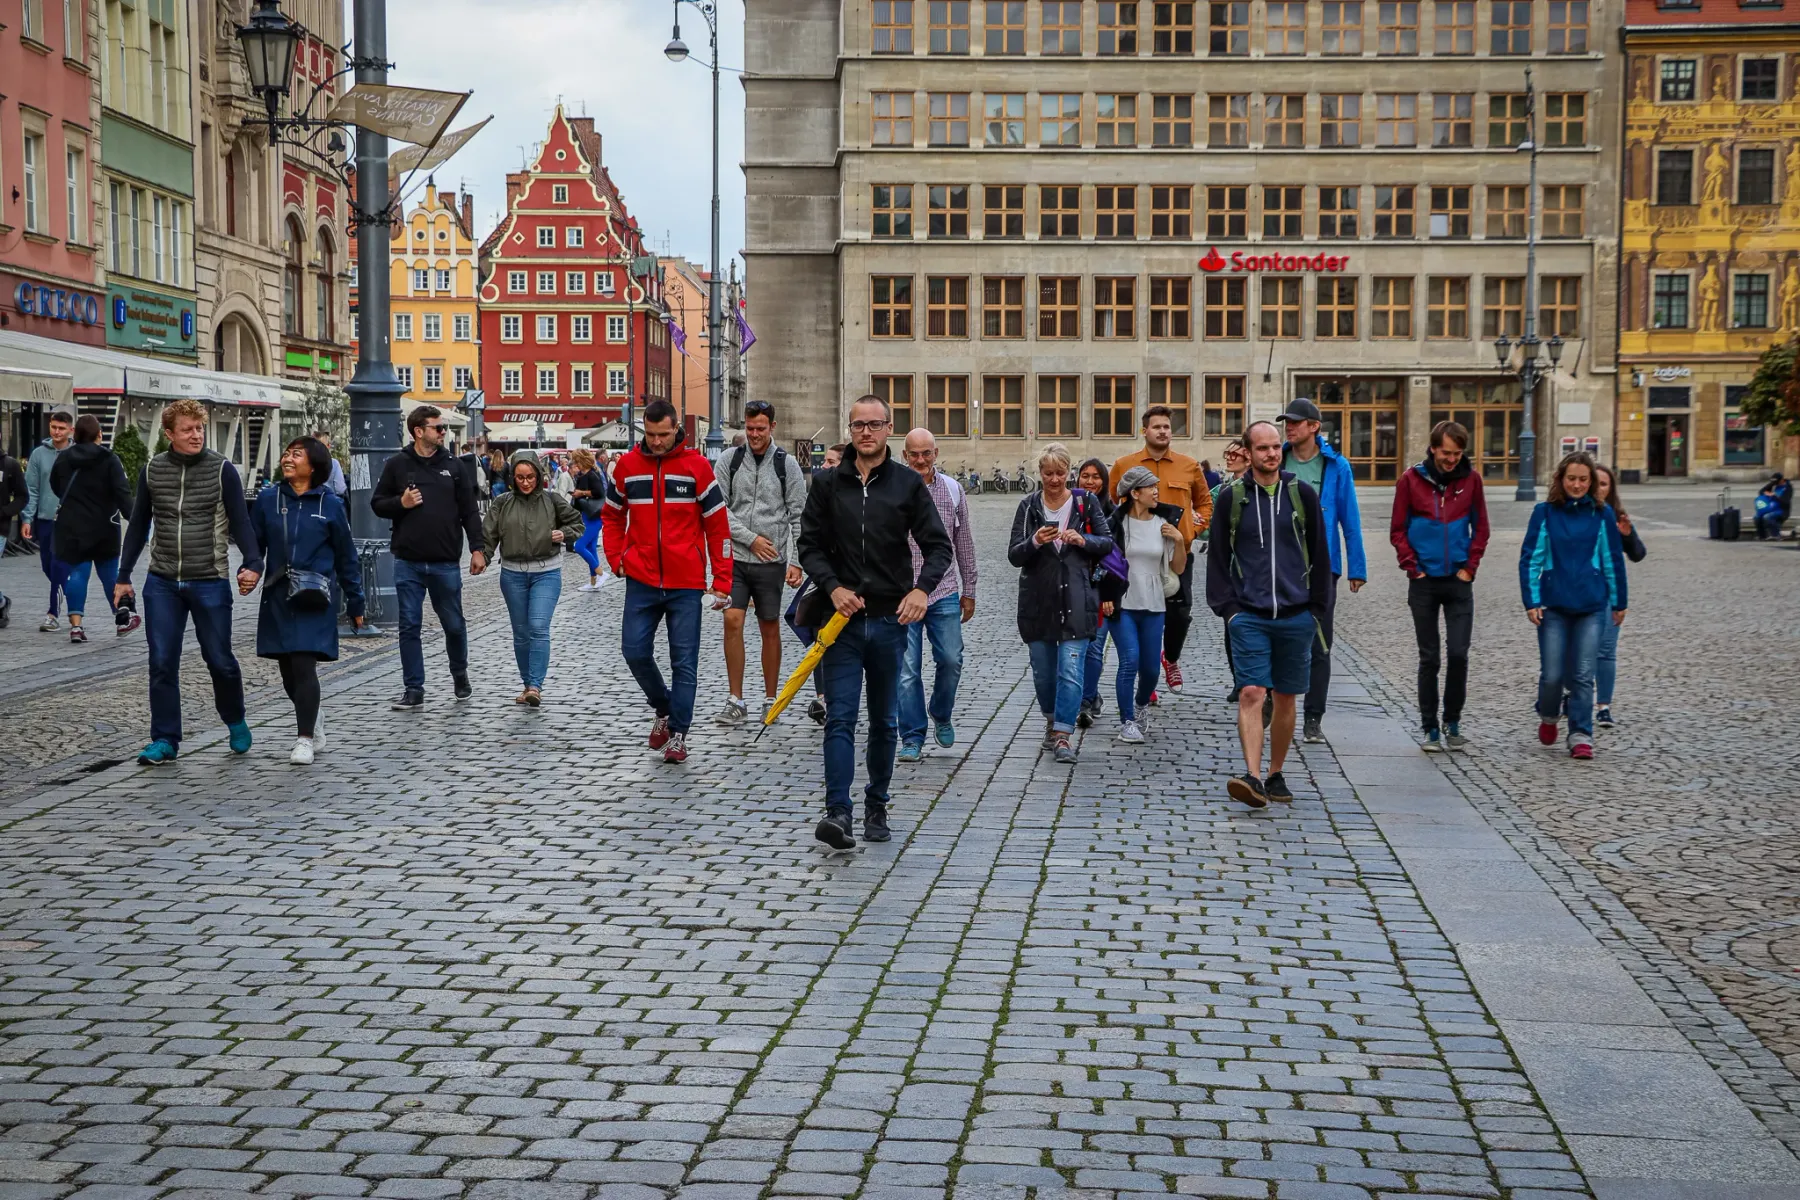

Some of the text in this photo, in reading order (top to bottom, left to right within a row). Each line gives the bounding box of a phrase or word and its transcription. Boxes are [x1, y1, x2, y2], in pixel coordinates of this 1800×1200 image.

[1231, 251, 1350, 272] Santander
[15, 282, 98, 325] GRECO
[503, 413, 564, 422] KOMBINAT
